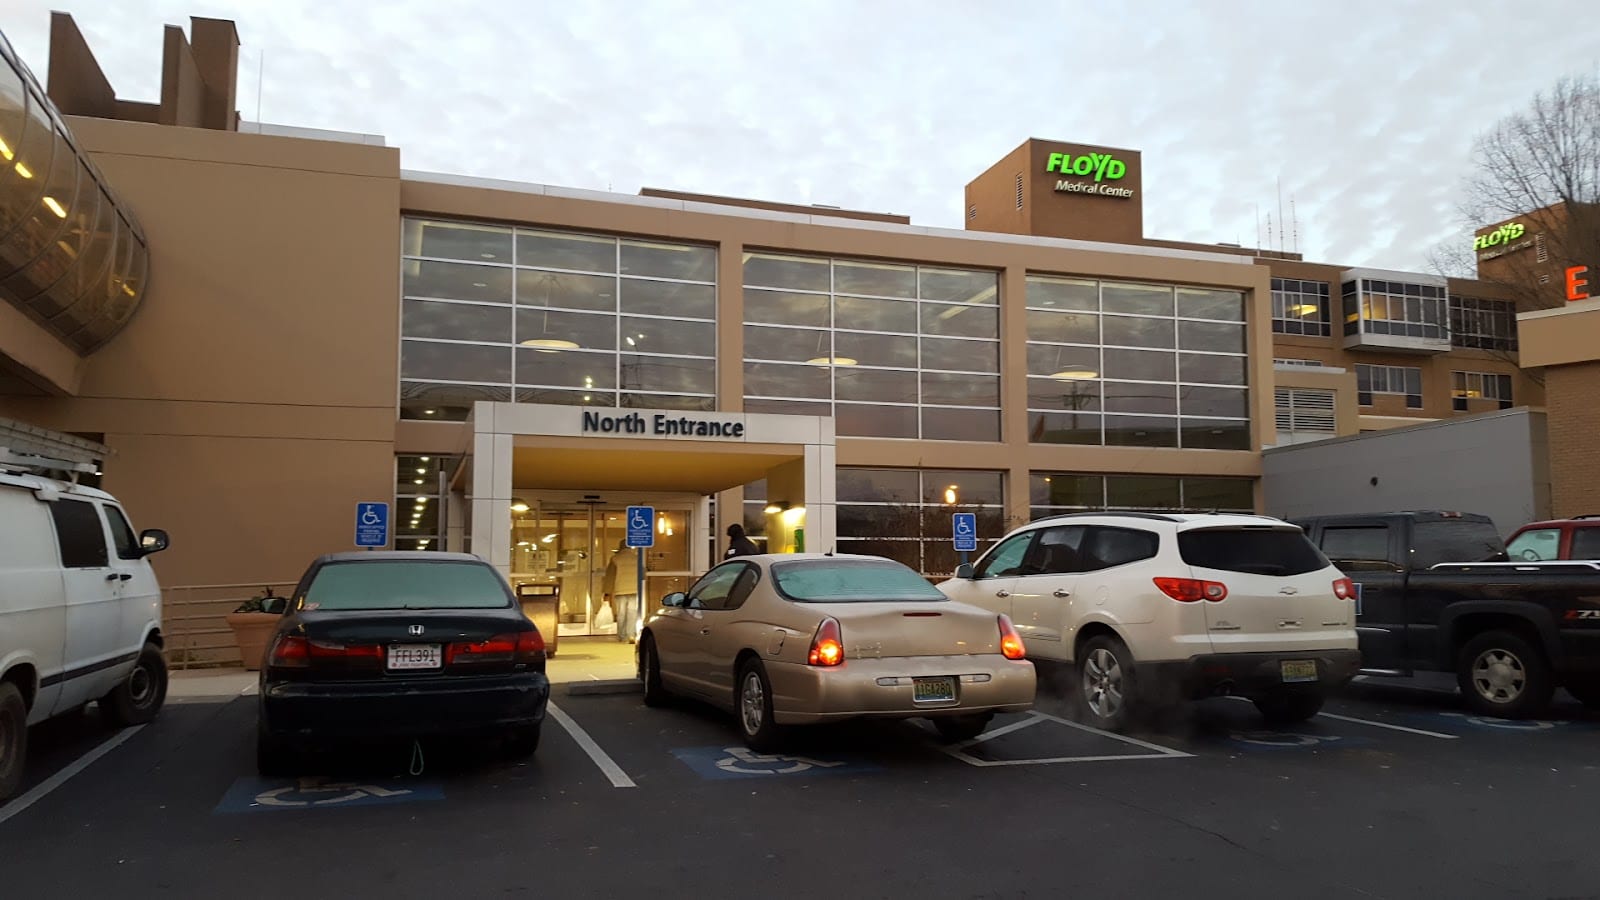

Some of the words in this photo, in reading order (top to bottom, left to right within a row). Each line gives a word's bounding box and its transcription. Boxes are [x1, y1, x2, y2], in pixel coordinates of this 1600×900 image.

[1046, 152, 1126, 182] FLOYD
[1055, 180, 1098, 194] Medical
[1099, 184, 1134, 198] Center
[1473, 222, 1525, 251] FLOYD
[1565, 265, 1590, 301] E
[583, 411, 646, 434] North
[653, 414, 745, 437] Entrance
[395, 649, 435, 662] FFL391
